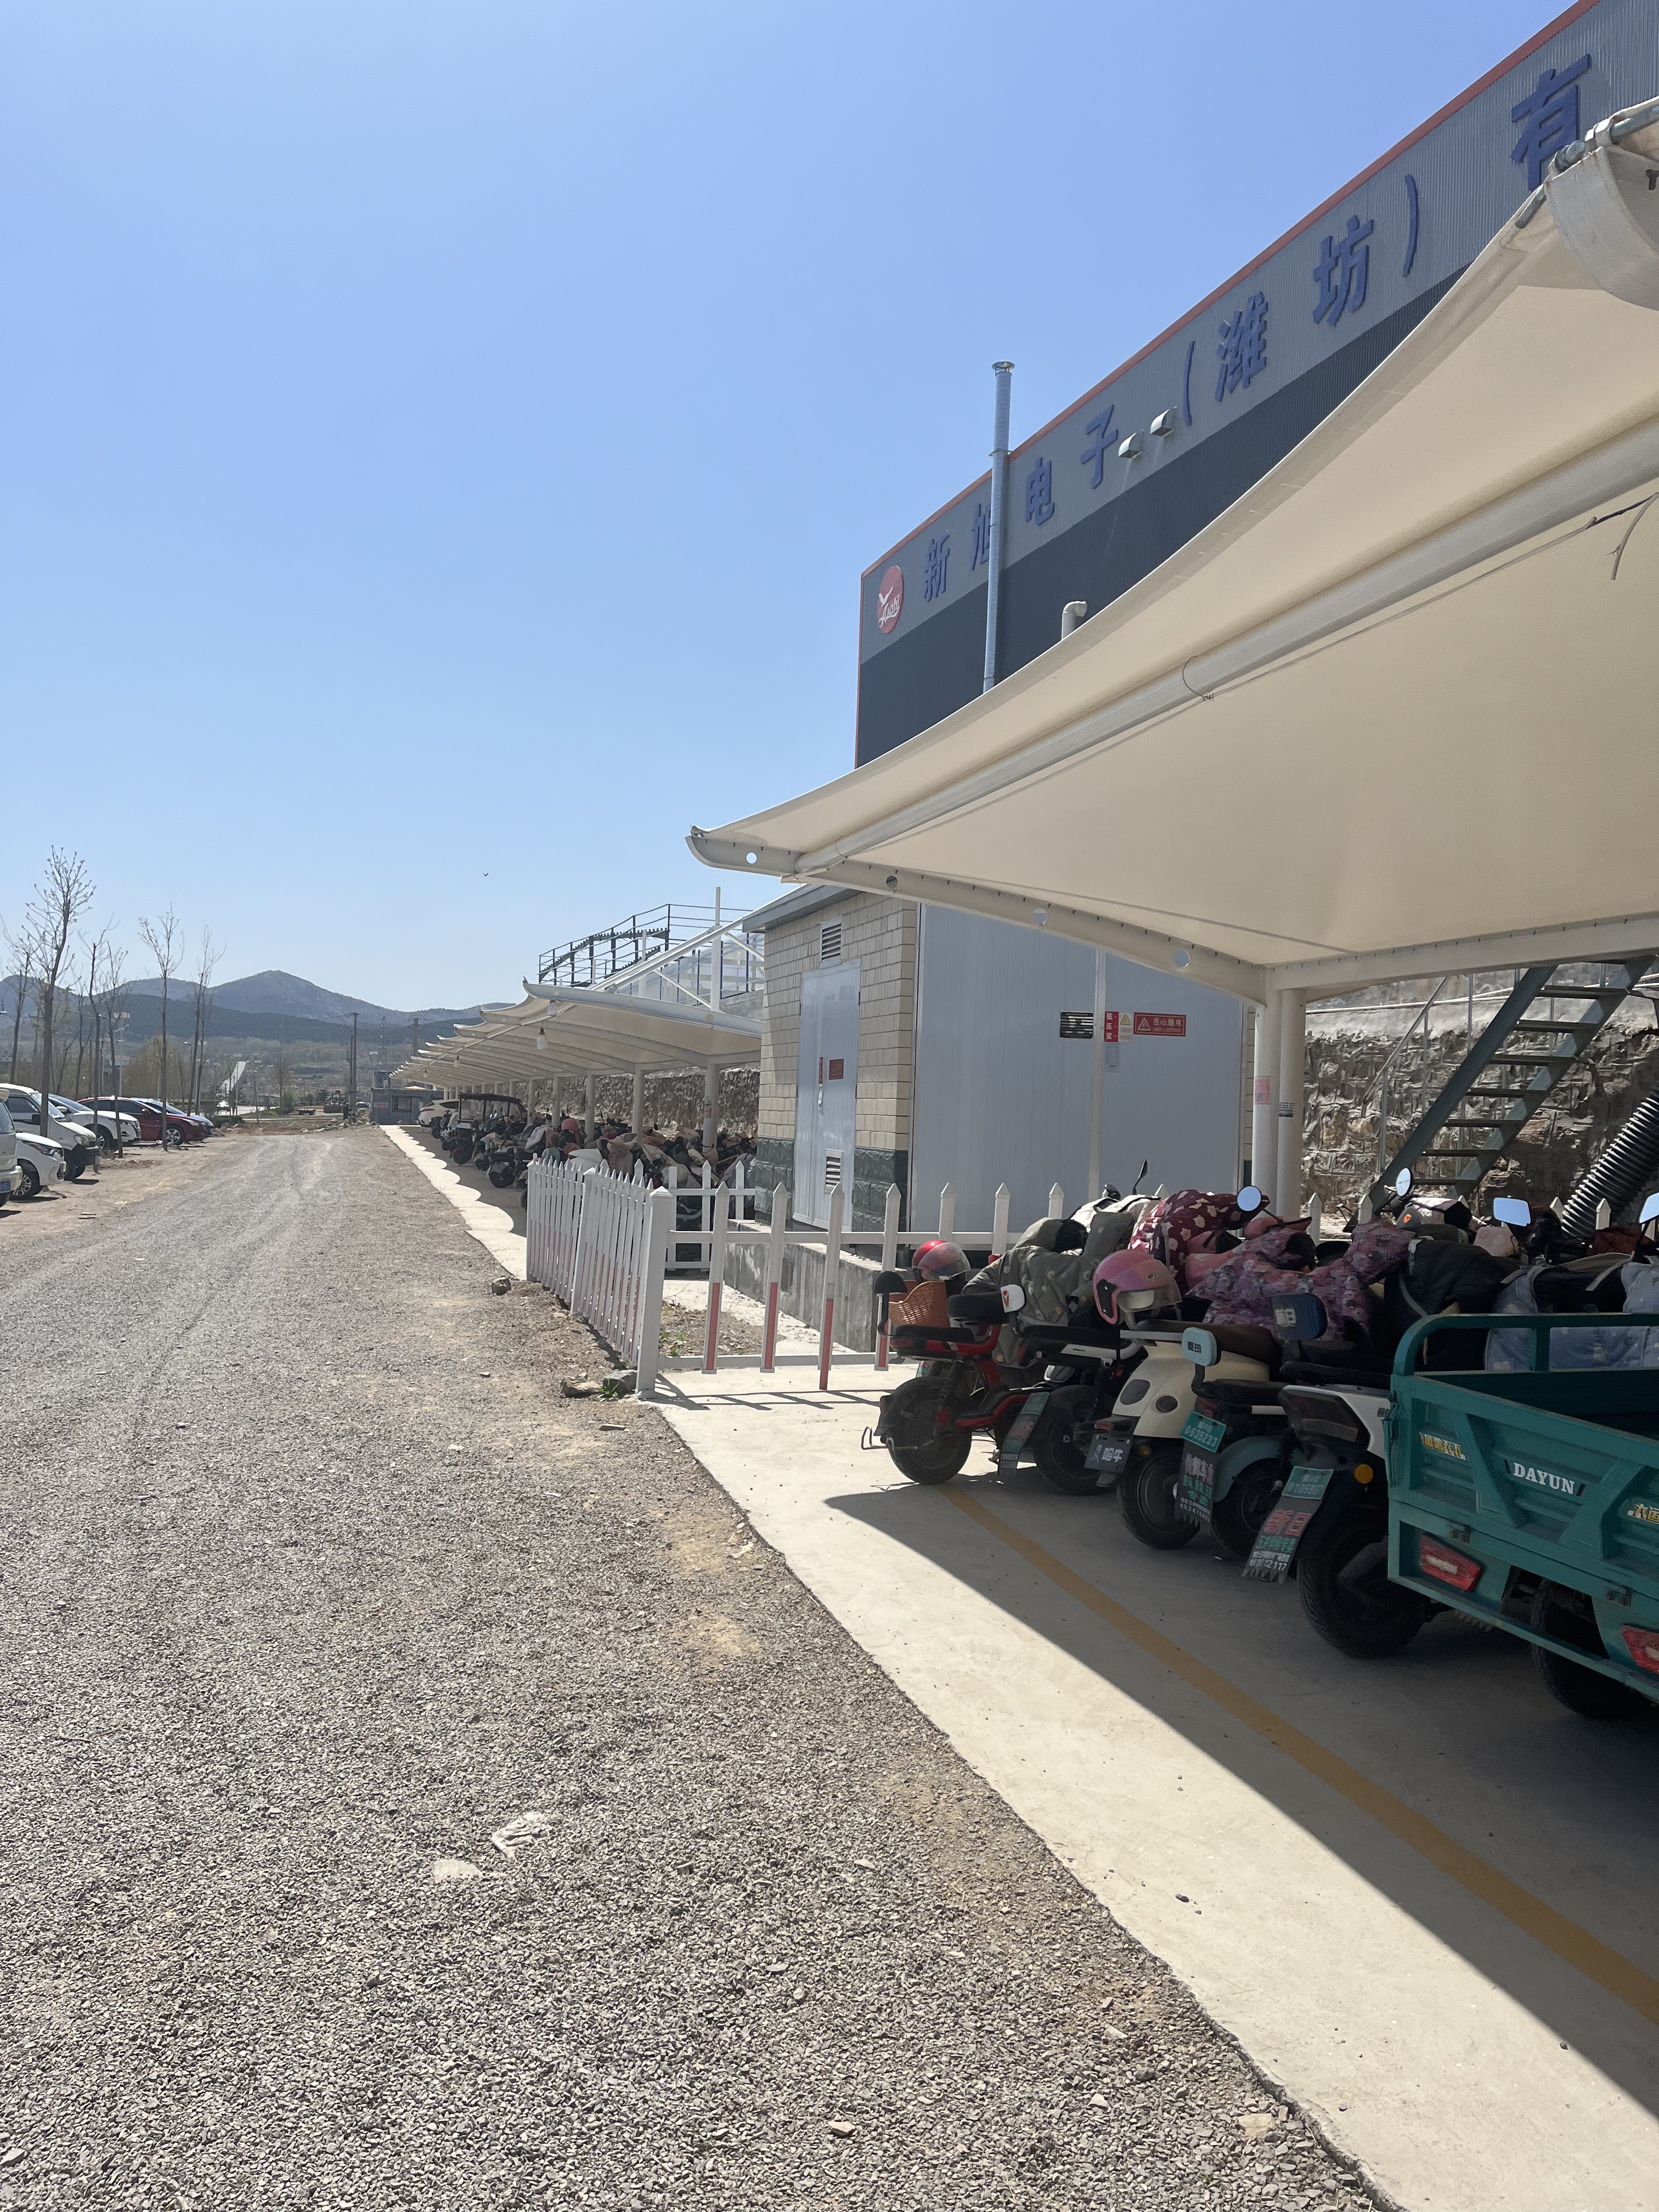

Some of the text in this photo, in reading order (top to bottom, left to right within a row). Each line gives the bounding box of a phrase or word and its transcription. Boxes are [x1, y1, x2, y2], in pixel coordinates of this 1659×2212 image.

[878, 594, 900, 628] Asahi
[1153, 1017, 1183, 1028] 当心触电
[1514, 1463, 1575, 1494] DAYUN
[1264, 1509, 1312, 1536] 新日
